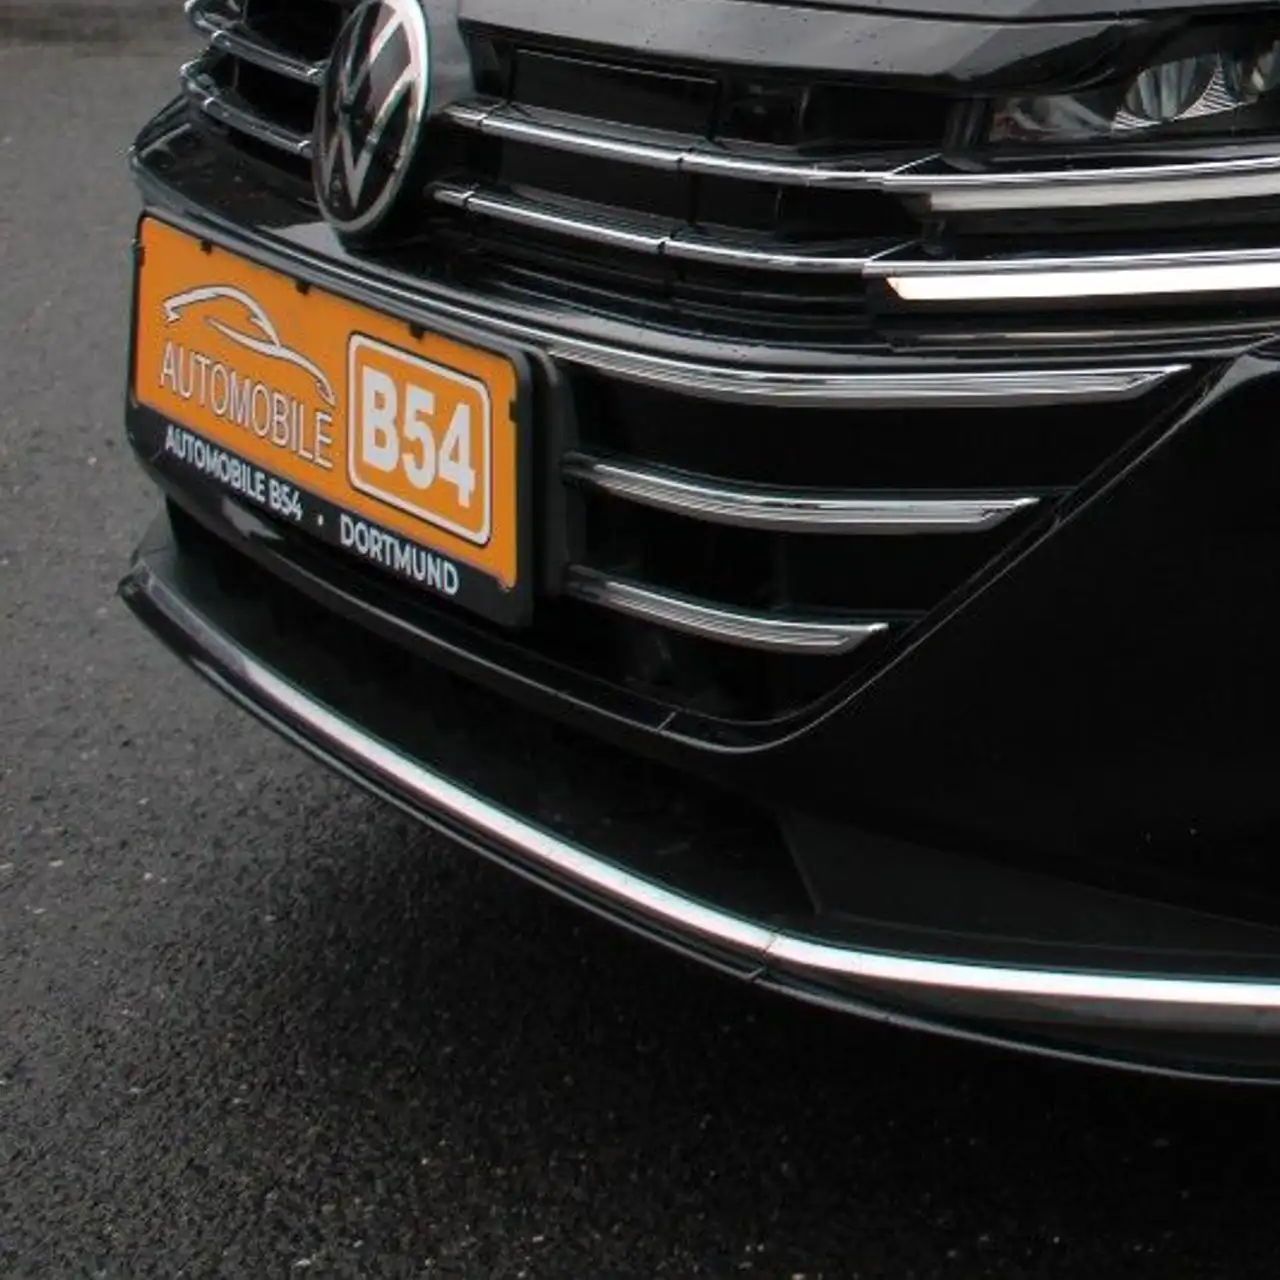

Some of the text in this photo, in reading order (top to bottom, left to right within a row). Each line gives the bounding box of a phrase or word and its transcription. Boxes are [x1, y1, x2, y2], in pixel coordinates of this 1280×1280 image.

[160, 342, 335, 470] AUTOMOBILE
[362, 365, 476, 508] B54
[165, 424, 460, 596] AUTOMOBILE B54 DORTMUND
